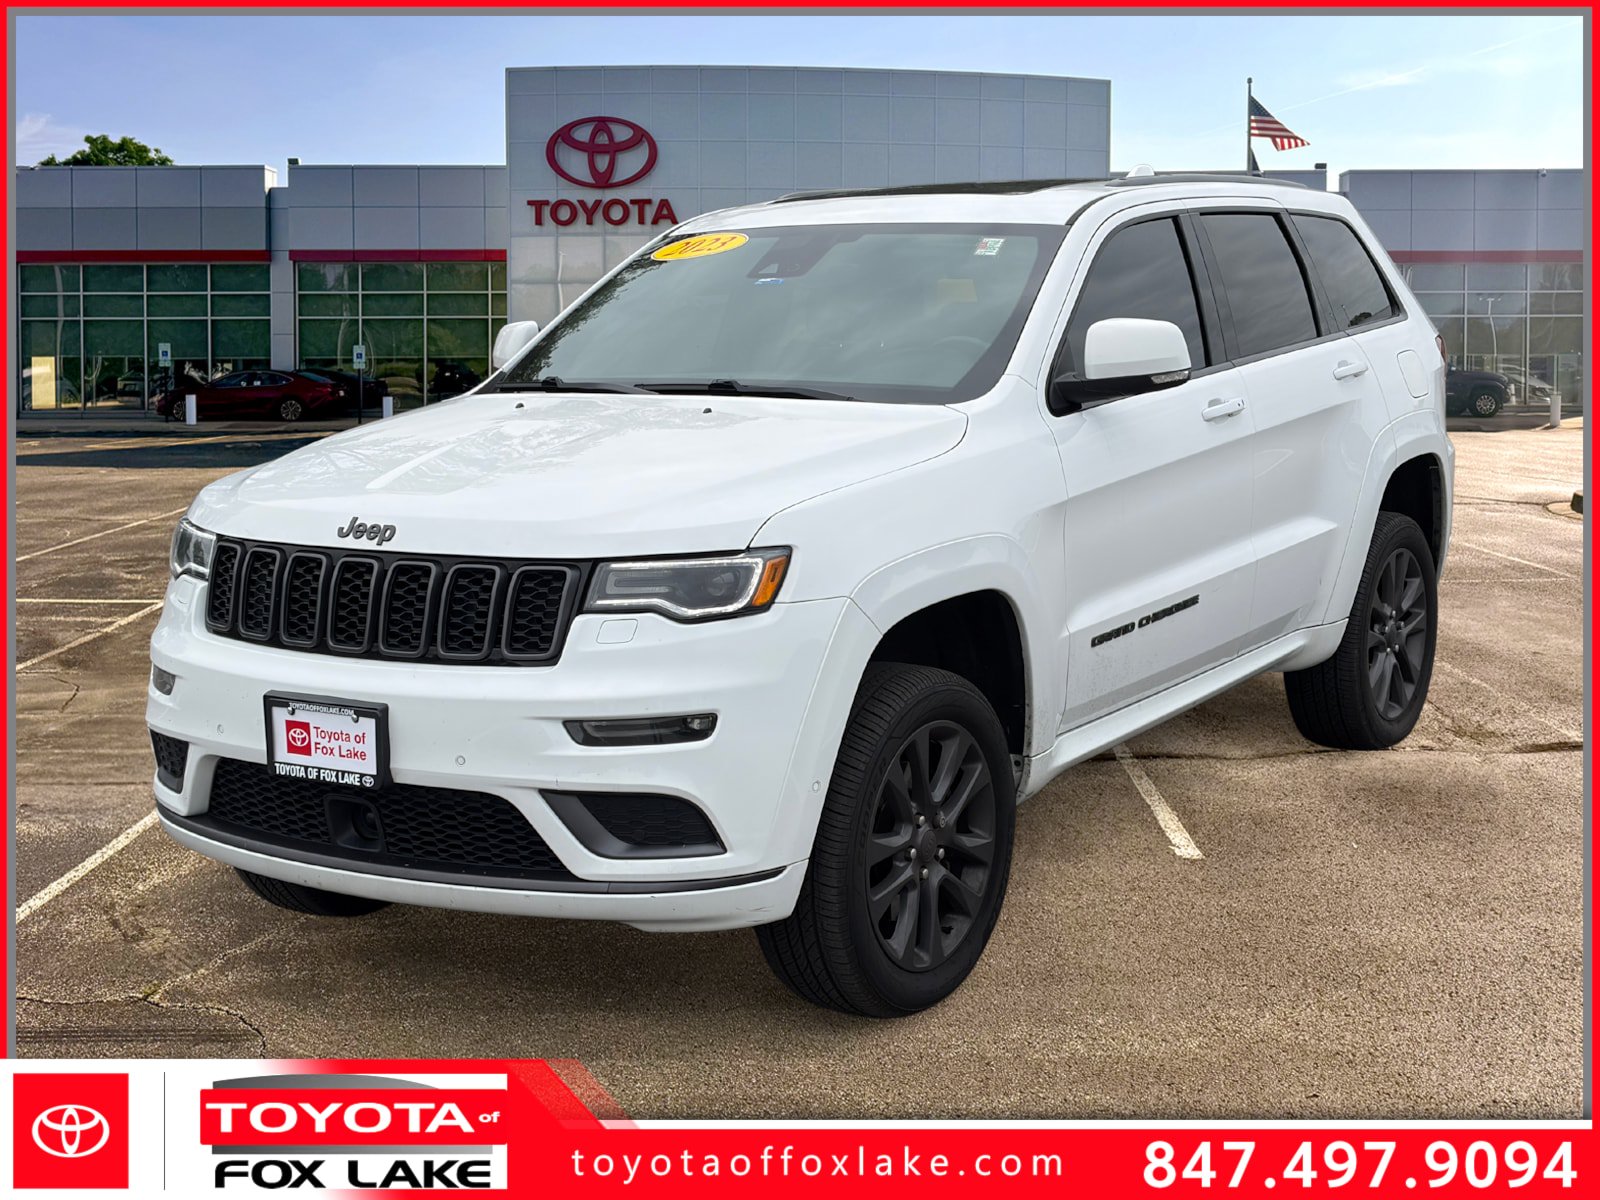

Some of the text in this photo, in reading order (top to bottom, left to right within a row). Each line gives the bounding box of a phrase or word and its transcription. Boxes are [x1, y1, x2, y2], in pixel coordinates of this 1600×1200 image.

[527, 198, 678, 226] TOYOTA
[662, 236, 737, 256] 2023
[337, 516, 397, 547] Jeep
[289, 702, 354, 715] TOYOTAOFFOXLAKE.COM
[313, 726, 366, 744] Toyota of
[314, 742, 366, 760] Fox Lake
[274, 763, 360, 785] TOYOTA OF FOX LAKE
